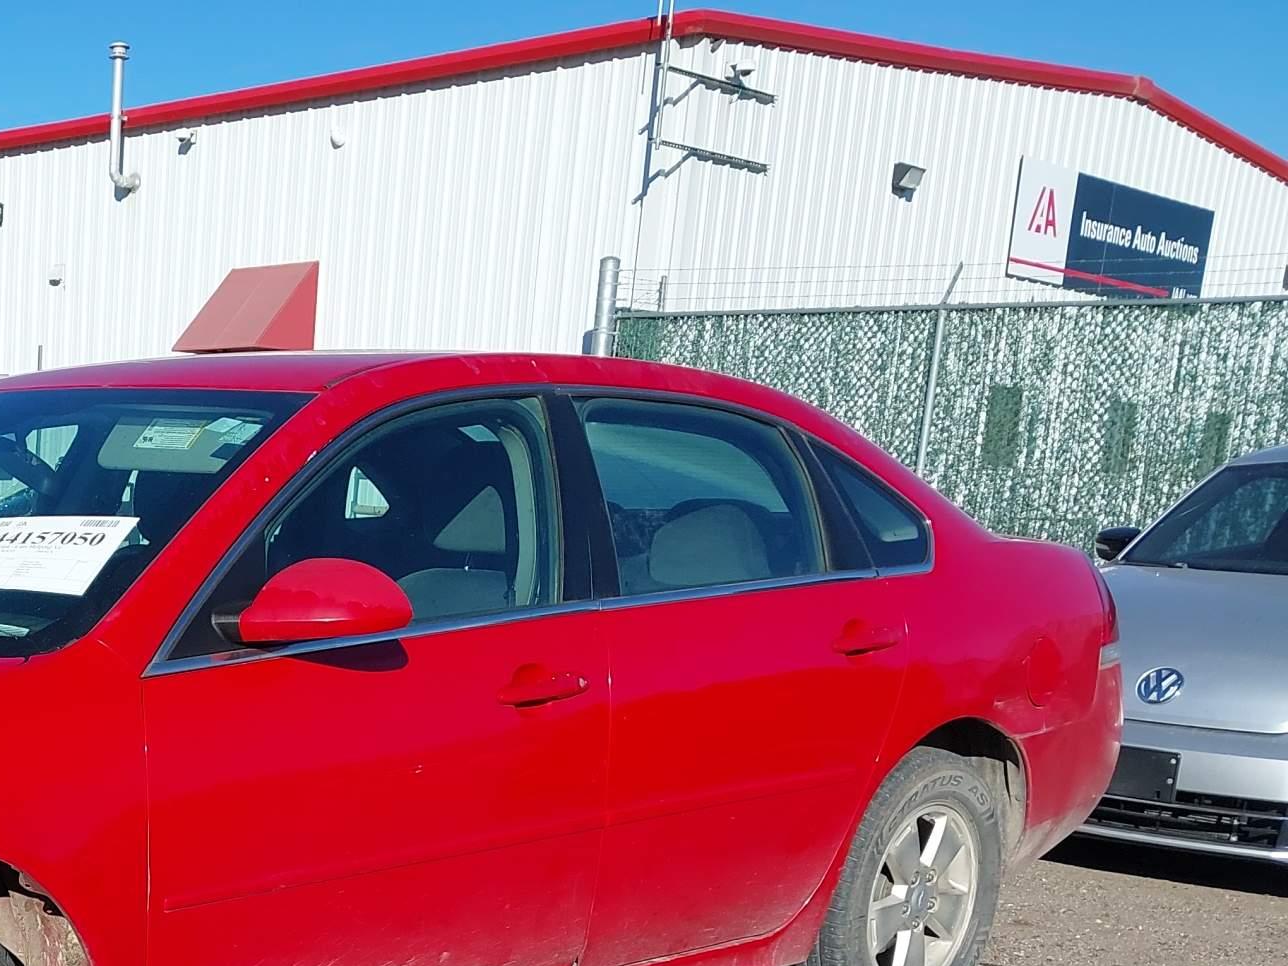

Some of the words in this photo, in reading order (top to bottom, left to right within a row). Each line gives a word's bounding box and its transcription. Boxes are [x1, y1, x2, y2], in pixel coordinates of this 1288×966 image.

[1080, 211, 1132, 248] Insurance
[1132, 225, 1156, 254] Auto
[1157, 231, 1200, 265] Auctions
[888, 775, 963, 832] STRATUS
[968, 785, 990, 807] AS
